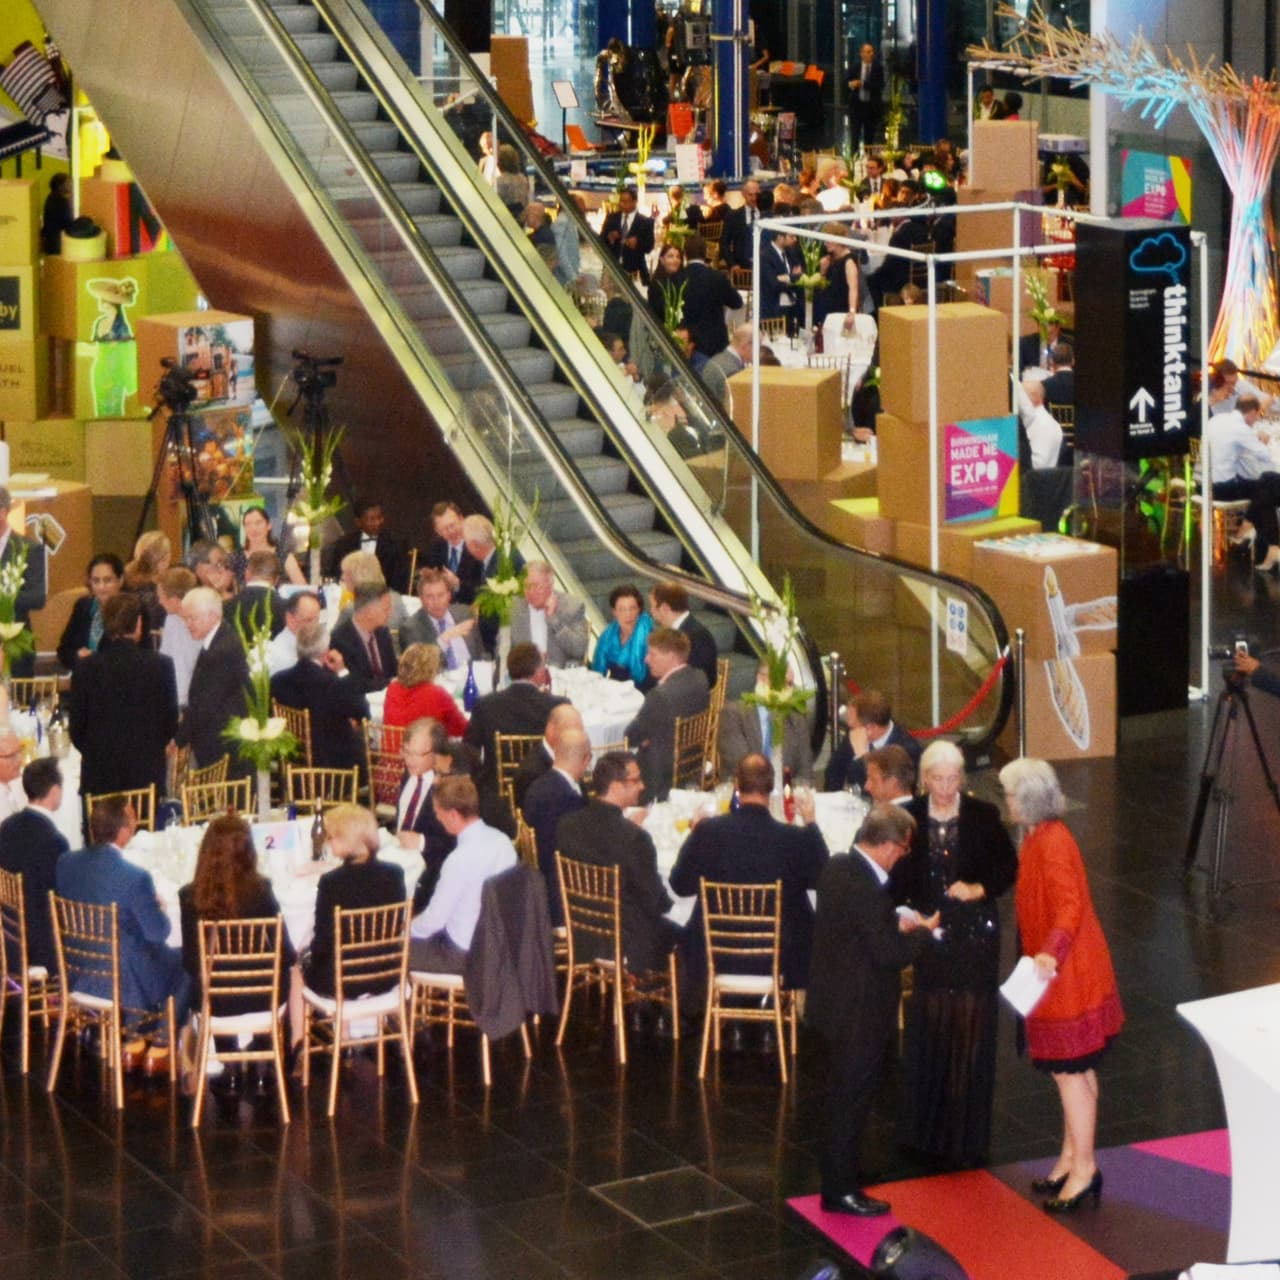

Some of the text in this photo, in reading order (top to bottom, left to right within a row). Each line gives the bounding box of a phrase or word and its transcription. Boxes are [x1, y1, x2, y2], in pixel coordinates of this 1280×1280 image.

[1163, 283, 1187, 431] thinktank
[951, 442, 999, 461] MADE ME
[950, 459, 999, 487] EXPO
